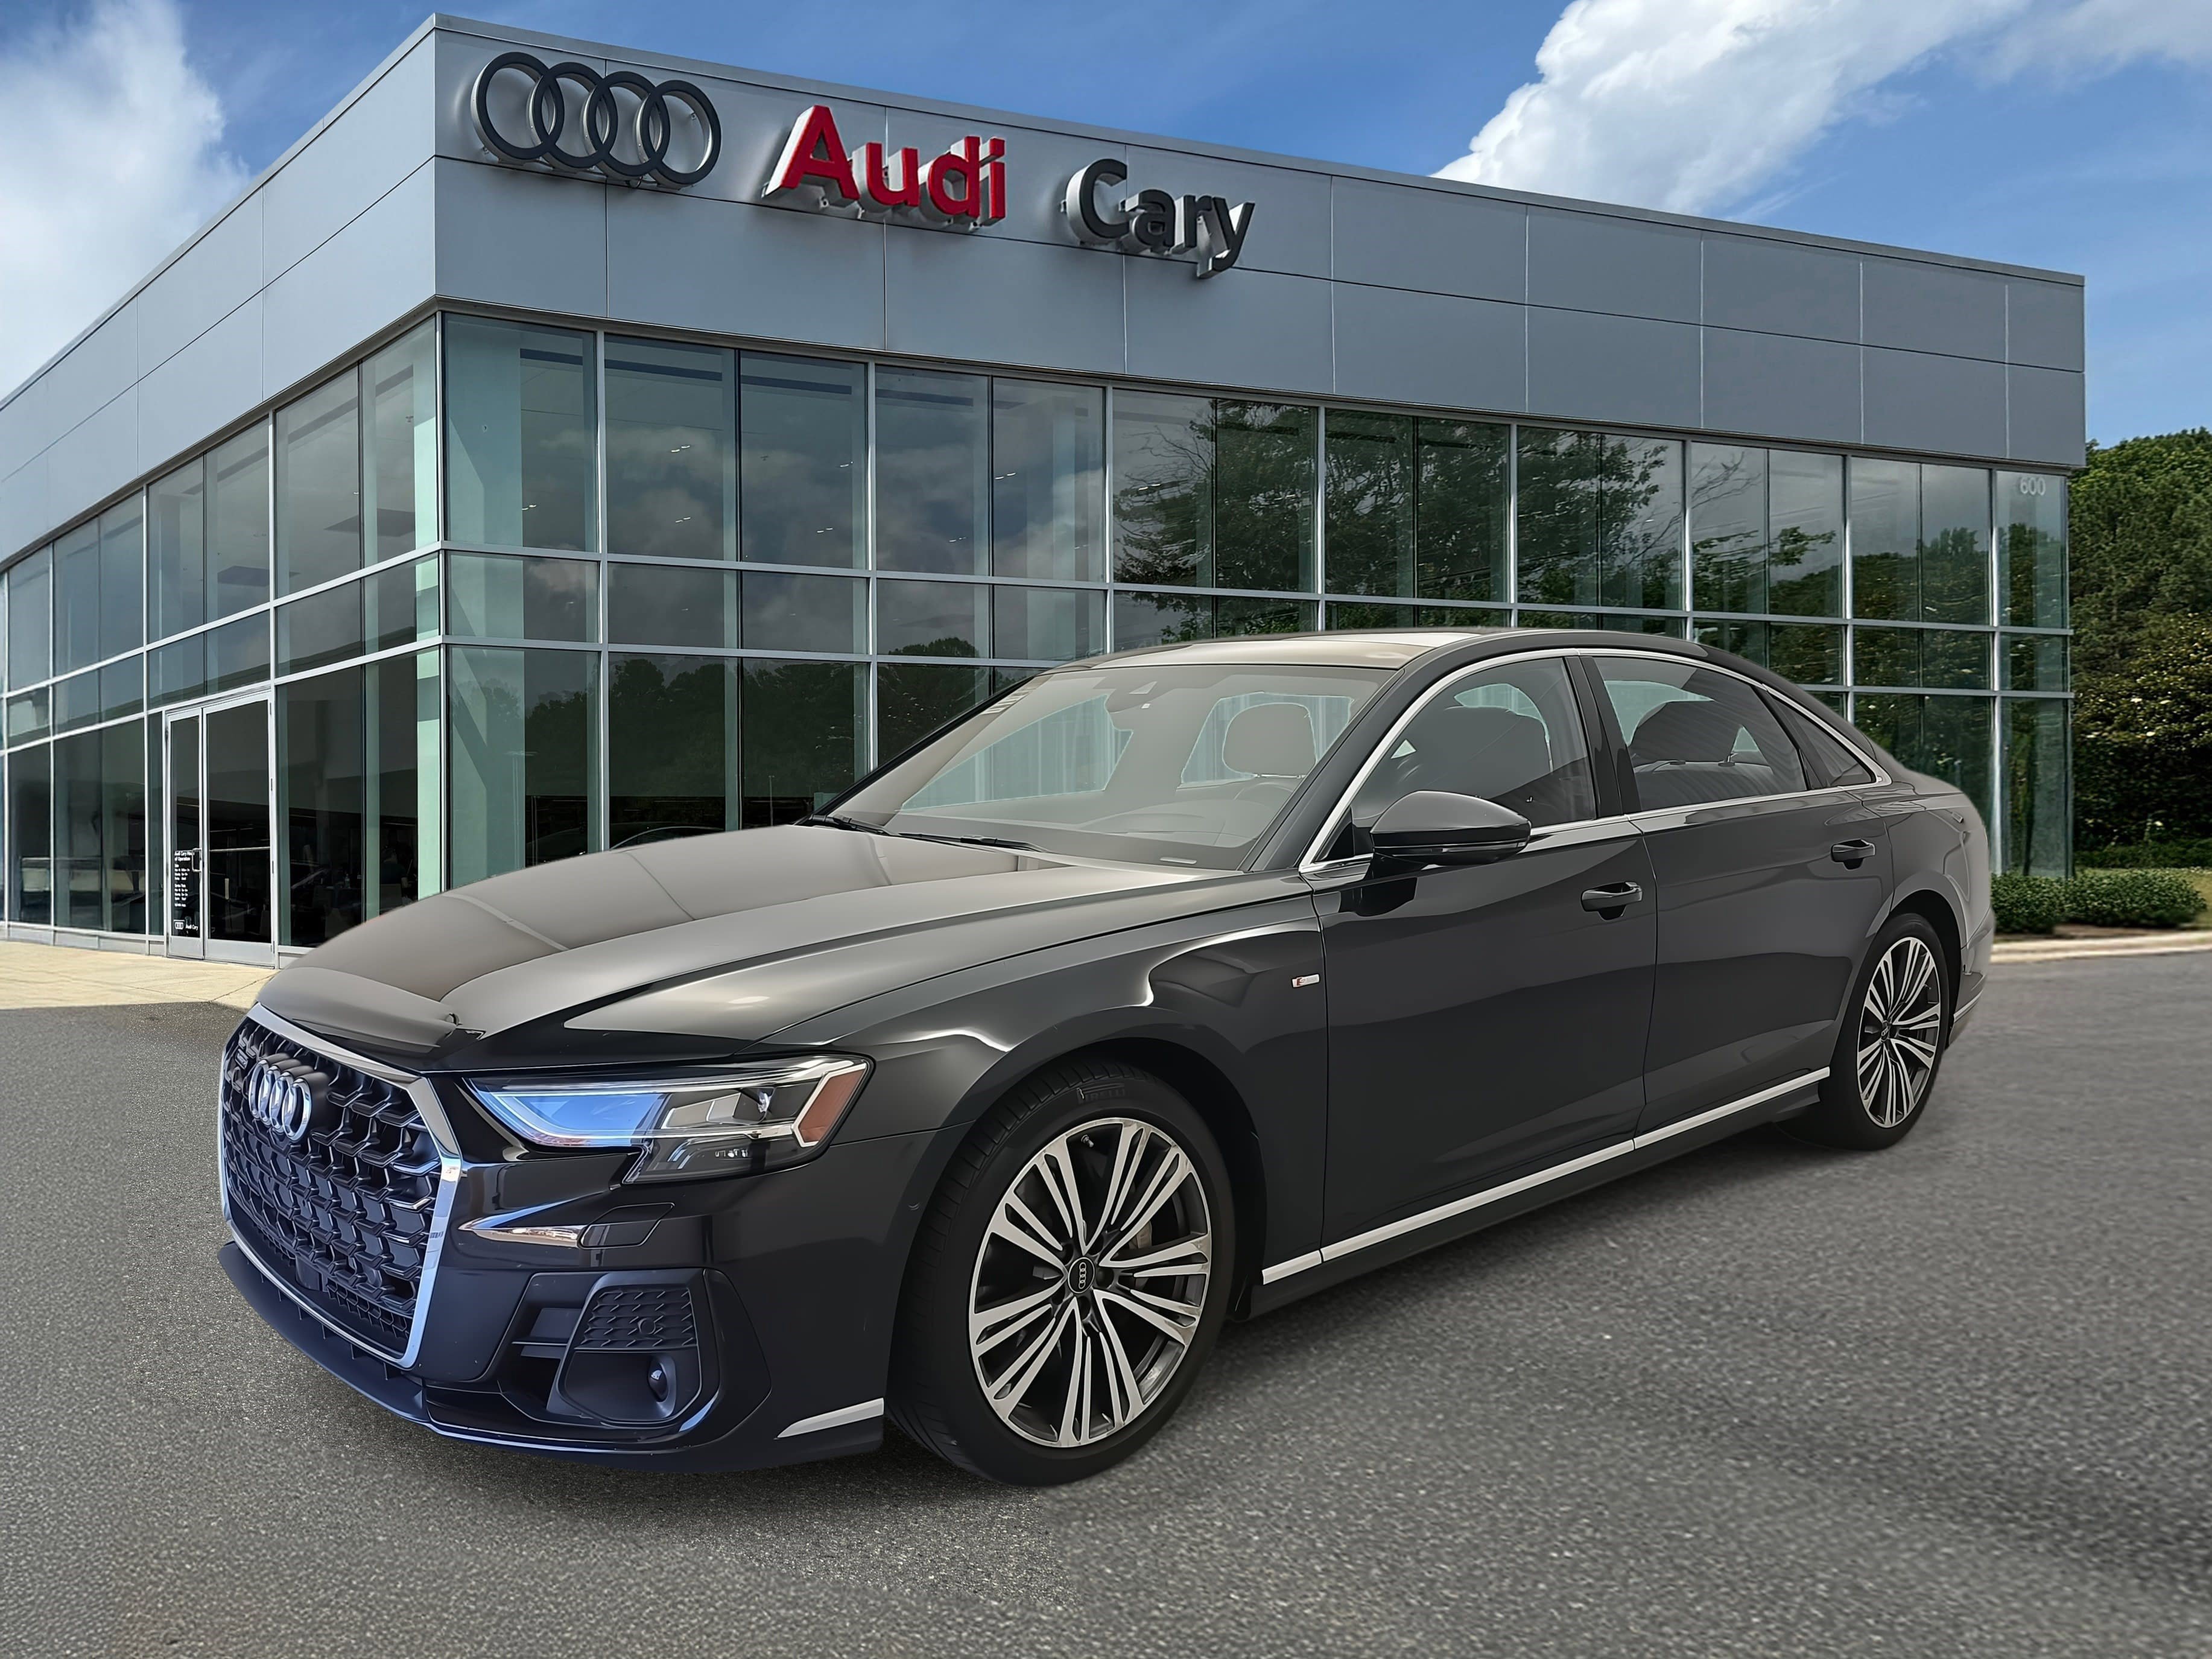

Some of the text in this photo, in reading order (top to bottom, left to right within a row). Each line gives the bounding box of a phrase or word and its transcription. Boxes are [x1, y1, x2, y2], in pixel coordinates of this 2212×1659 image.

[765, 104, 1255, 278] Audi Cary
[2020, 476, 2046, 495] 600
